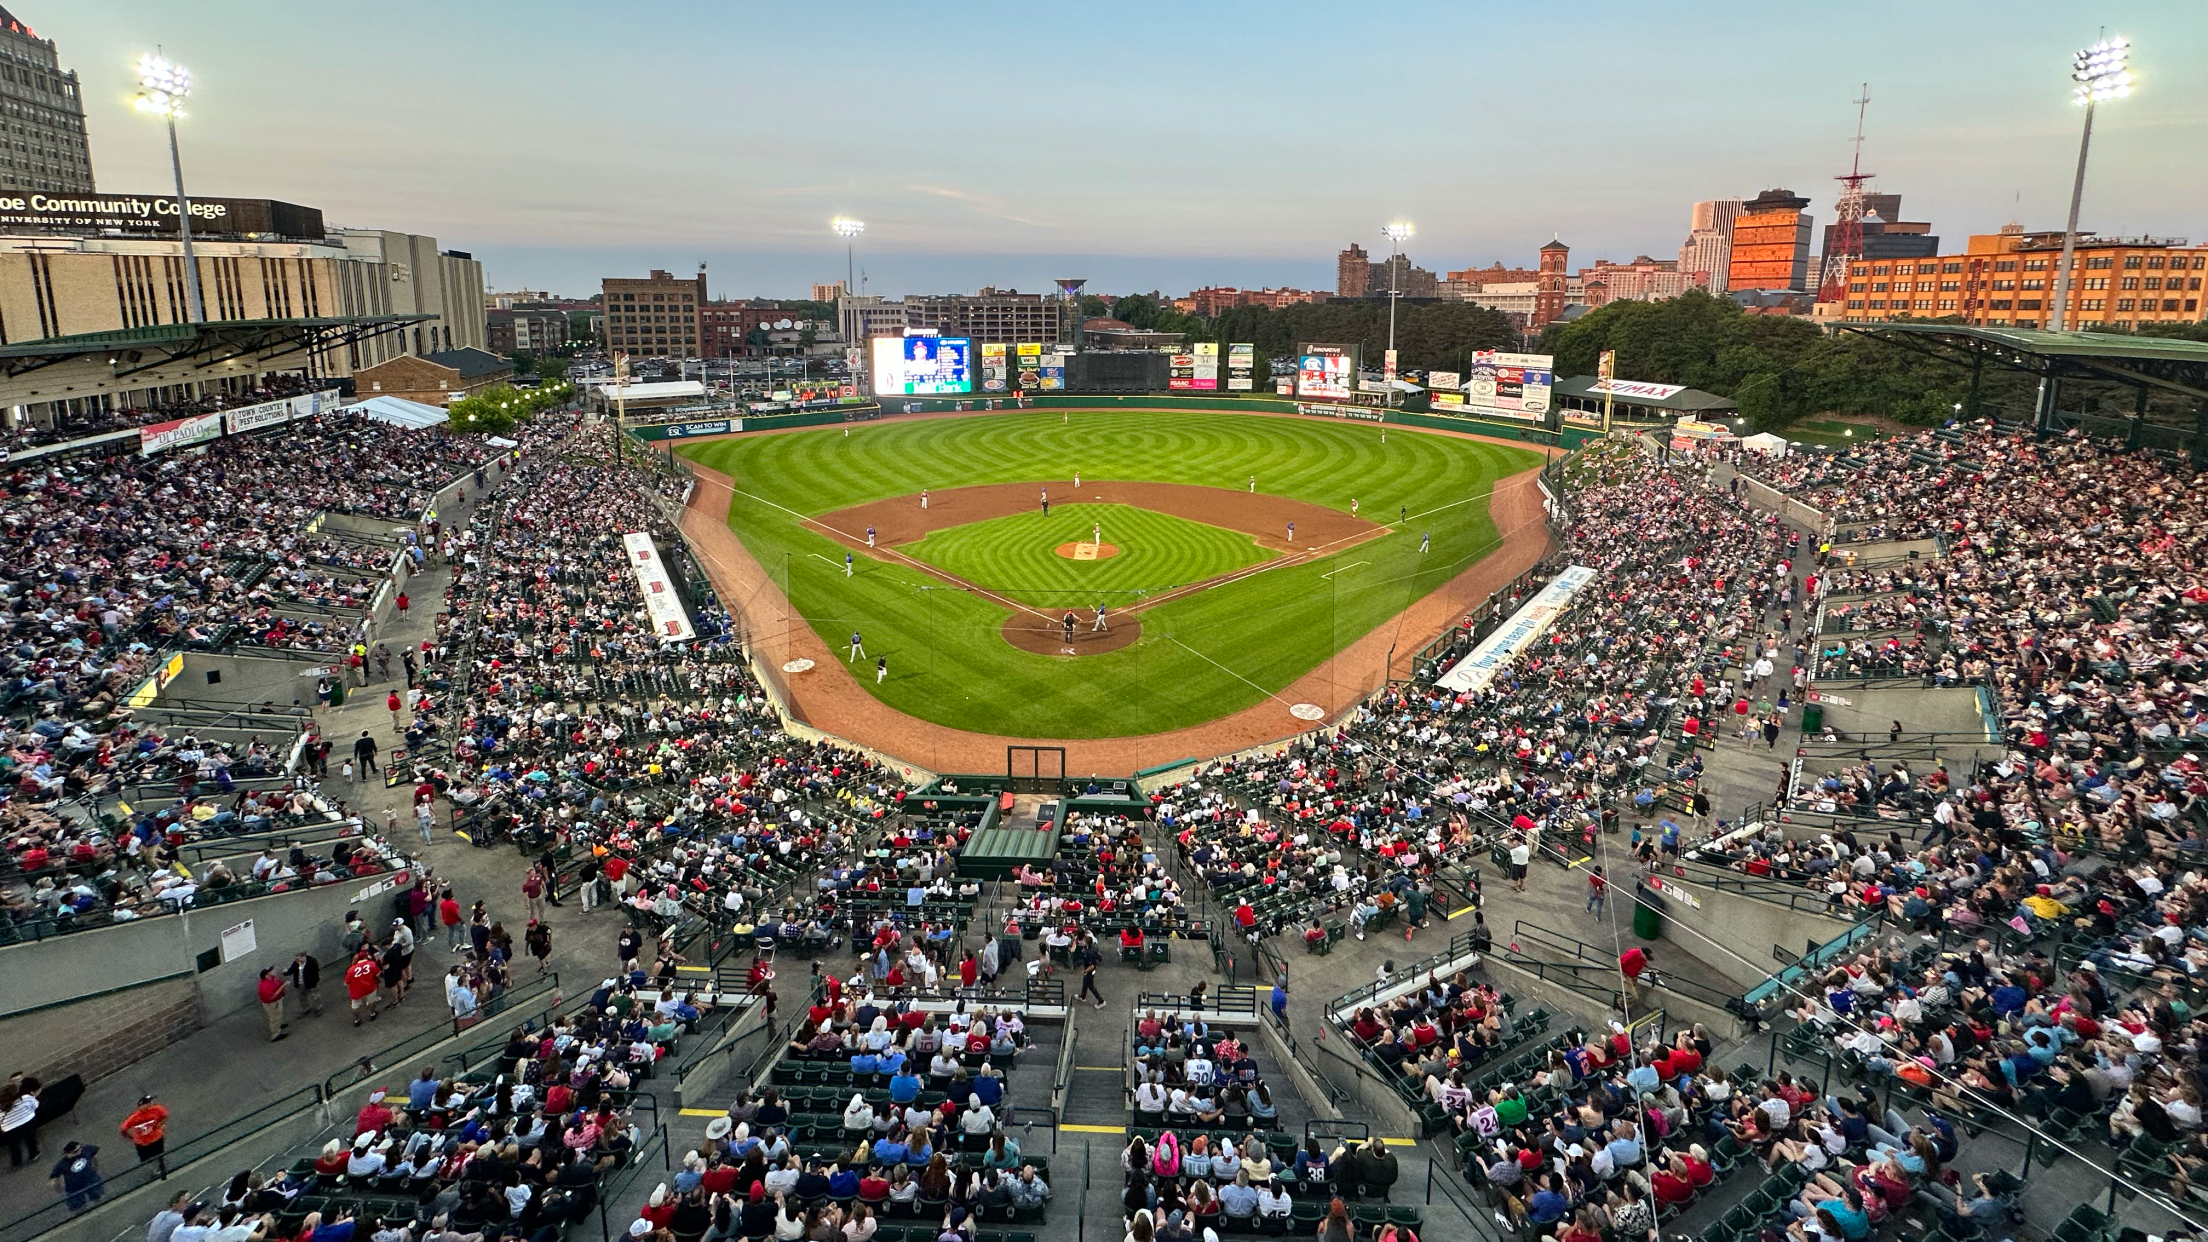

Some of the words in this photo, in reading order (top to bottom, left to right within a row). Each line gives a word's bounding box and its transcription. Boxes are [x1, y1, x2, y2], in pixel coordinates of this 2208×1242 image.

[31, 194, 152, 218] Community
[154, 199, 226, 219] Colege
[0, 216, 71, 225] NIVERSITY
[95, 218, 123, 226] NEW
[127, 219, 160, 227] YORK
[1471, 367, 1497, 375] CAMERON
[1594, 383, 1675, 396] E/MAX
[238, 407, 256, 419] TOWN
[259, 402, 283, 413] COUNTRY
[240, 416, 254, 426] PEST
[254, 410, 285, 423] SOLUTIONS
[158, 431, 170, 443] DI
[173, 424, 204, 440] PAOLO
[1523, 605, 1551, 620] health
[1516, 619, 1536, 628] for
[1504, 626, 1529, 640] team
[1485, 640, 1515, 656] home
[1470, 655, 1497, 669] Your
[354, 964, 370, 978] 23
[920, 1041, 934, 1051] 10
[1194, 1072, 1209, 1084] 30
[1446, 1096, 1466, 1107] 24
[1480, 1113, 1499, 1133] 24
[1308, 1167, 1325, 1181] 38
